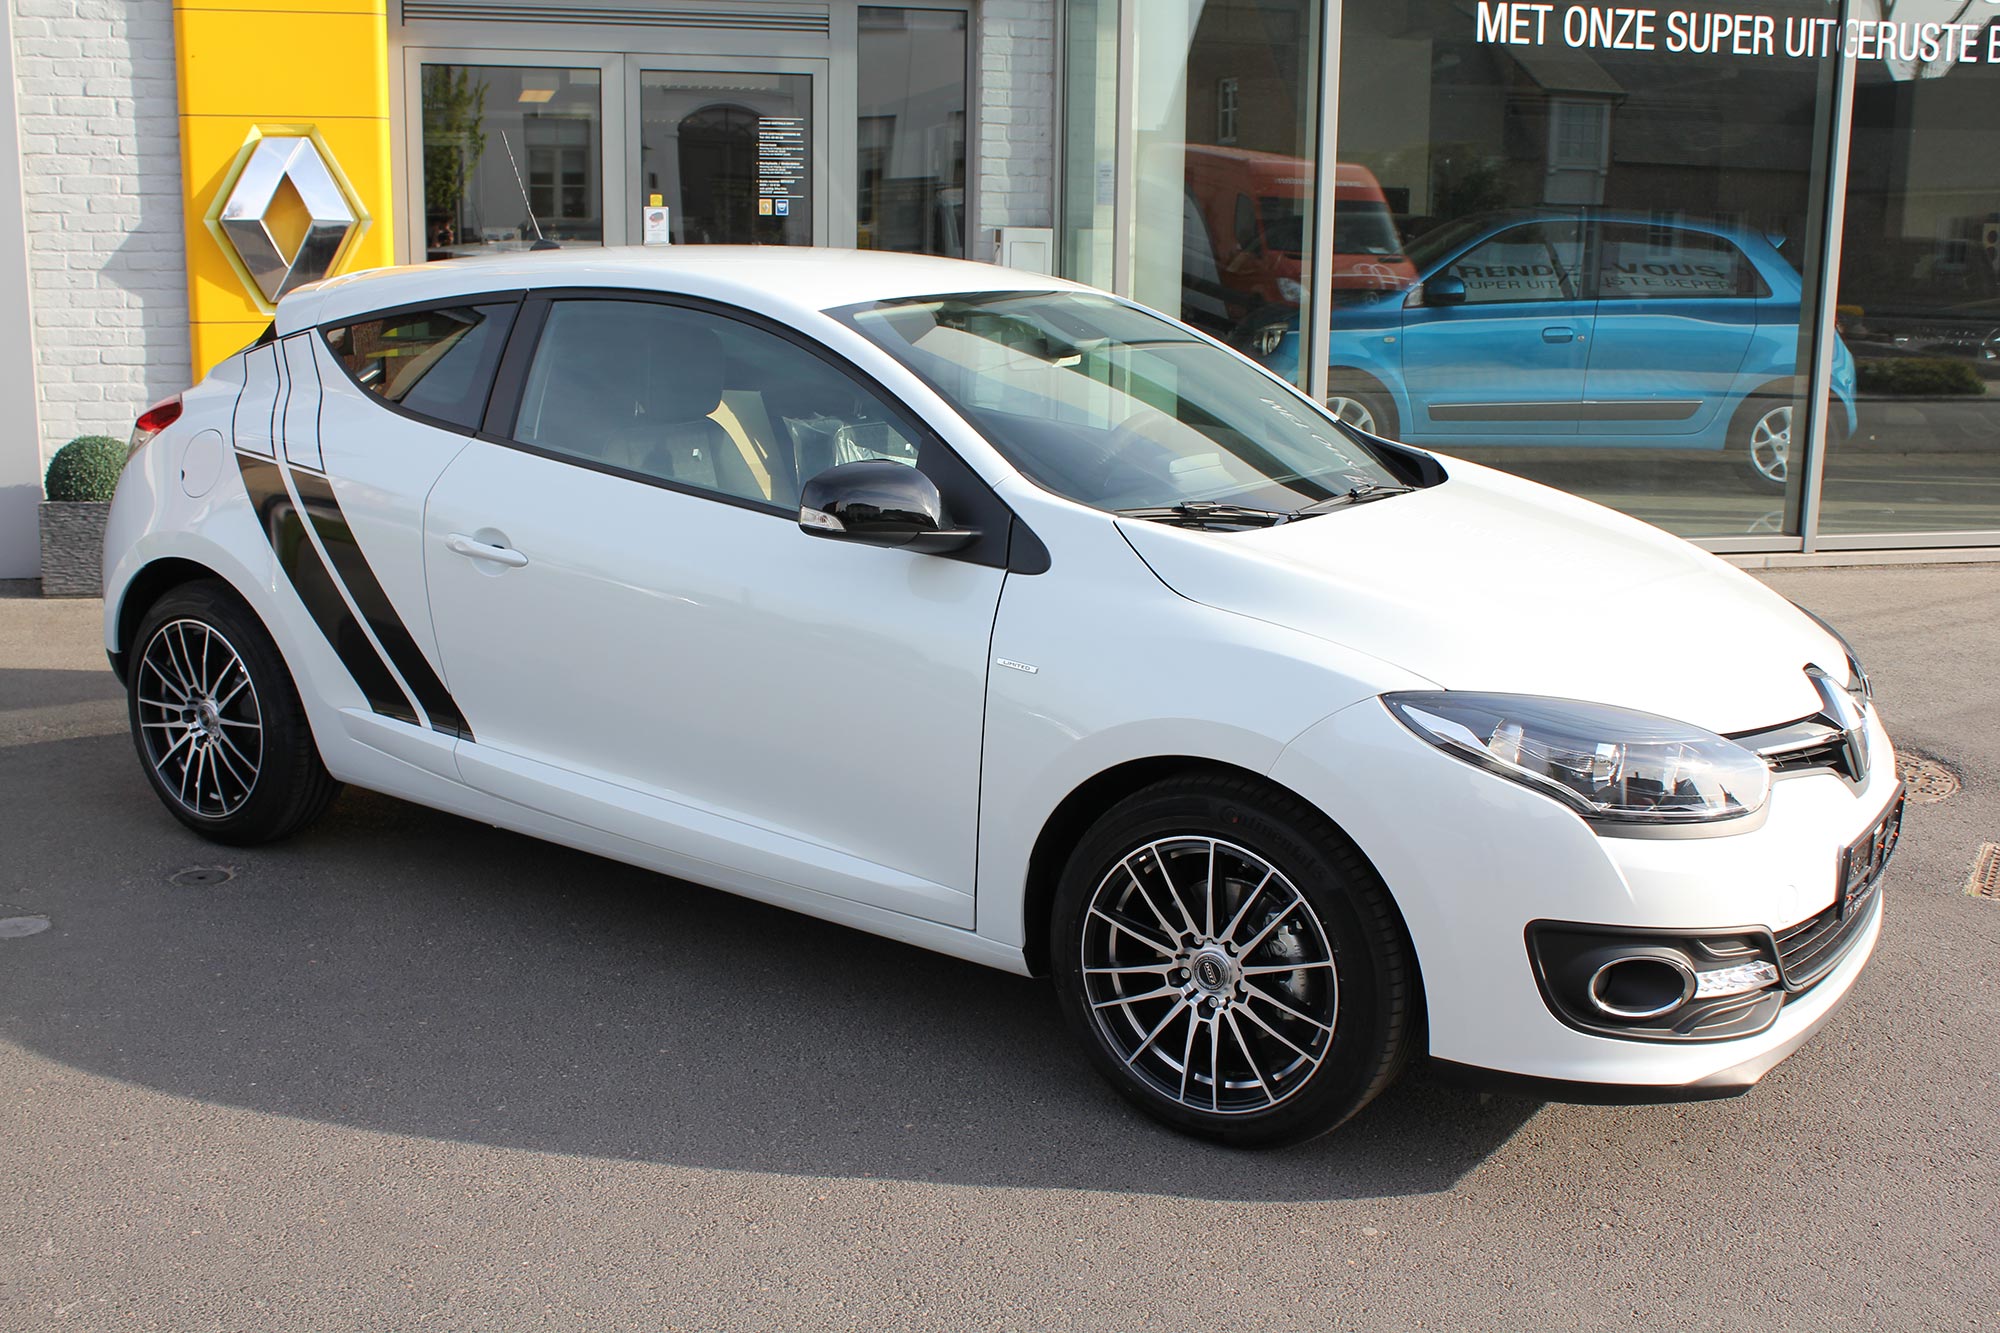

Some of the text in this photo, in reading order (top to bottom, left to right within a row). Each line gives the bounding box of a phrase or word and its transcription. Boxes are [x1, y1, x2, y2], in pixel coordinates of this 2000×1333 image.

[1476, 1, 1554, 45] MET
[1563, 5, 1656, 51] ONZE
[1665, 10, 1775, 56] SUPER
[1785, 16, 1980, 63] UITGERUSTE
[1464, 280, 1521, 290] UPER
